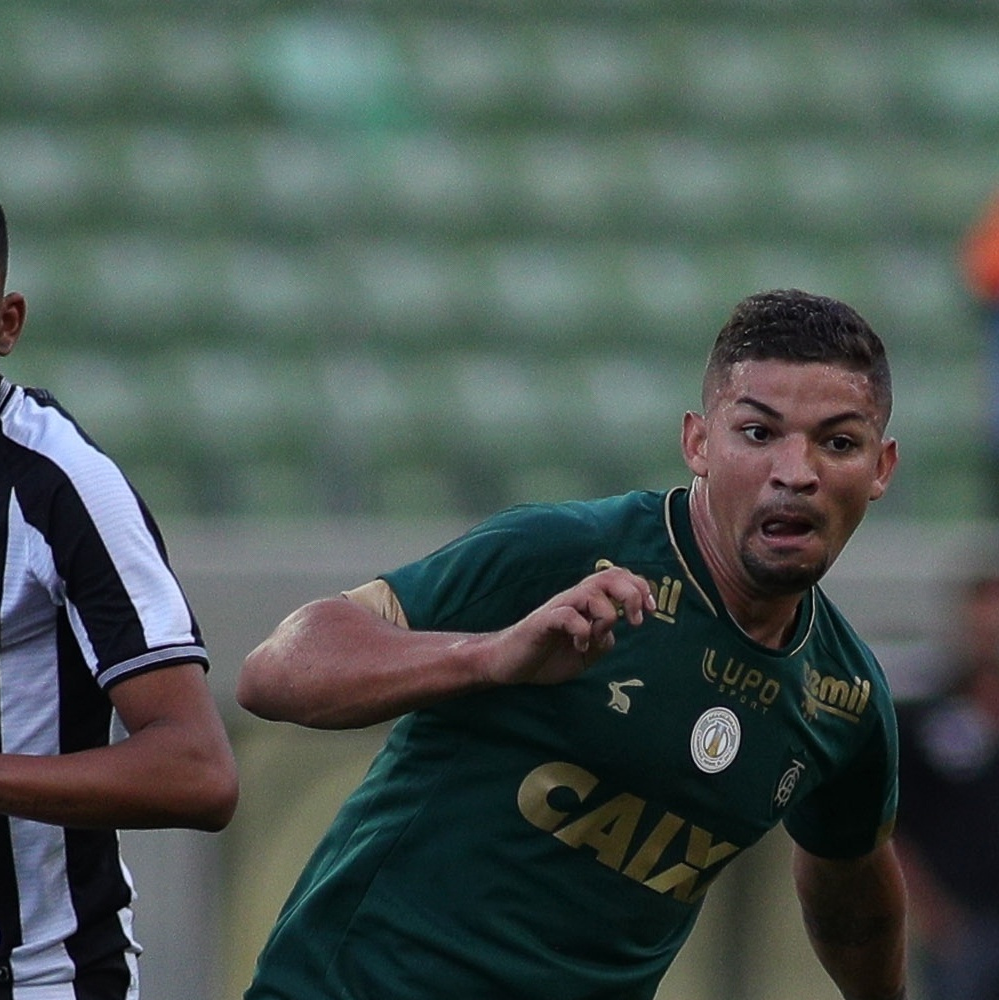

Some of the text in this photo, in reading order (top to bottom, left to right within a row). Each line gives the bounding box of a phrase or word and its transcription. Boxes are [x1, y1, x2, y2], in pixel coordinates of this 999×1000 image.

[702, 648, 780, 704] LUPO
[718, 684, 769, 714] SPORT
[517, 761, 740, 904] CAIX
